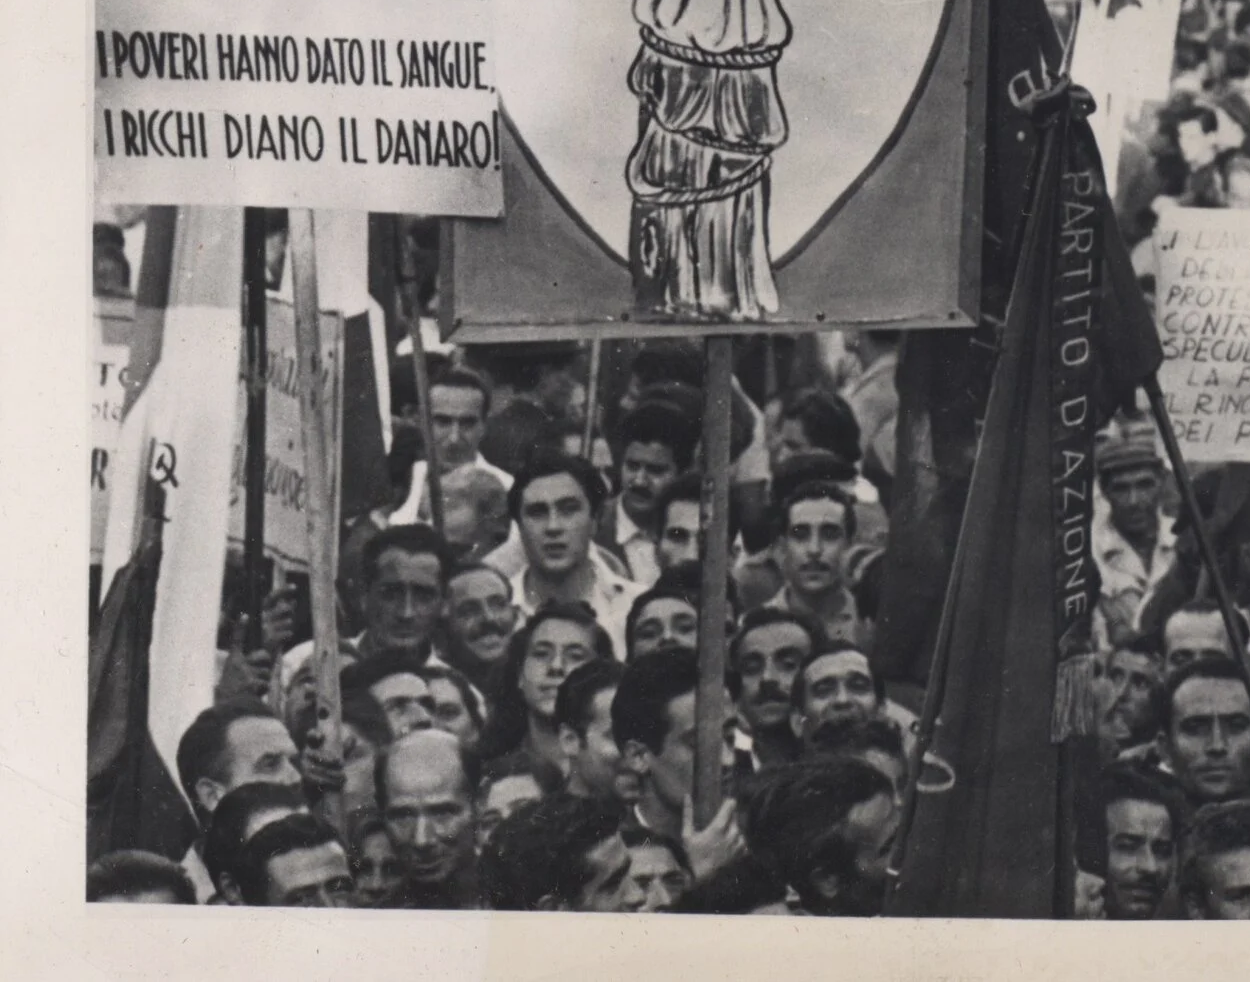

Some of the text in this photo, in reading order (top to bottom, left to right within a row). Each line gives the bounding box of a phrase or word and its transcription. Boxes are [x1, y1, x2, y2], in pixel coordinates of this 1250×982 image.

[96, 30, 496, 93] I POVERI HANNO DATO IL SANGUE,
[104, 109, 501, 171] I RICCHI DIANO IL DANARO!
[1187, 368, 1219, 386] LA
[1173, 419, 1214, 443] DEI
